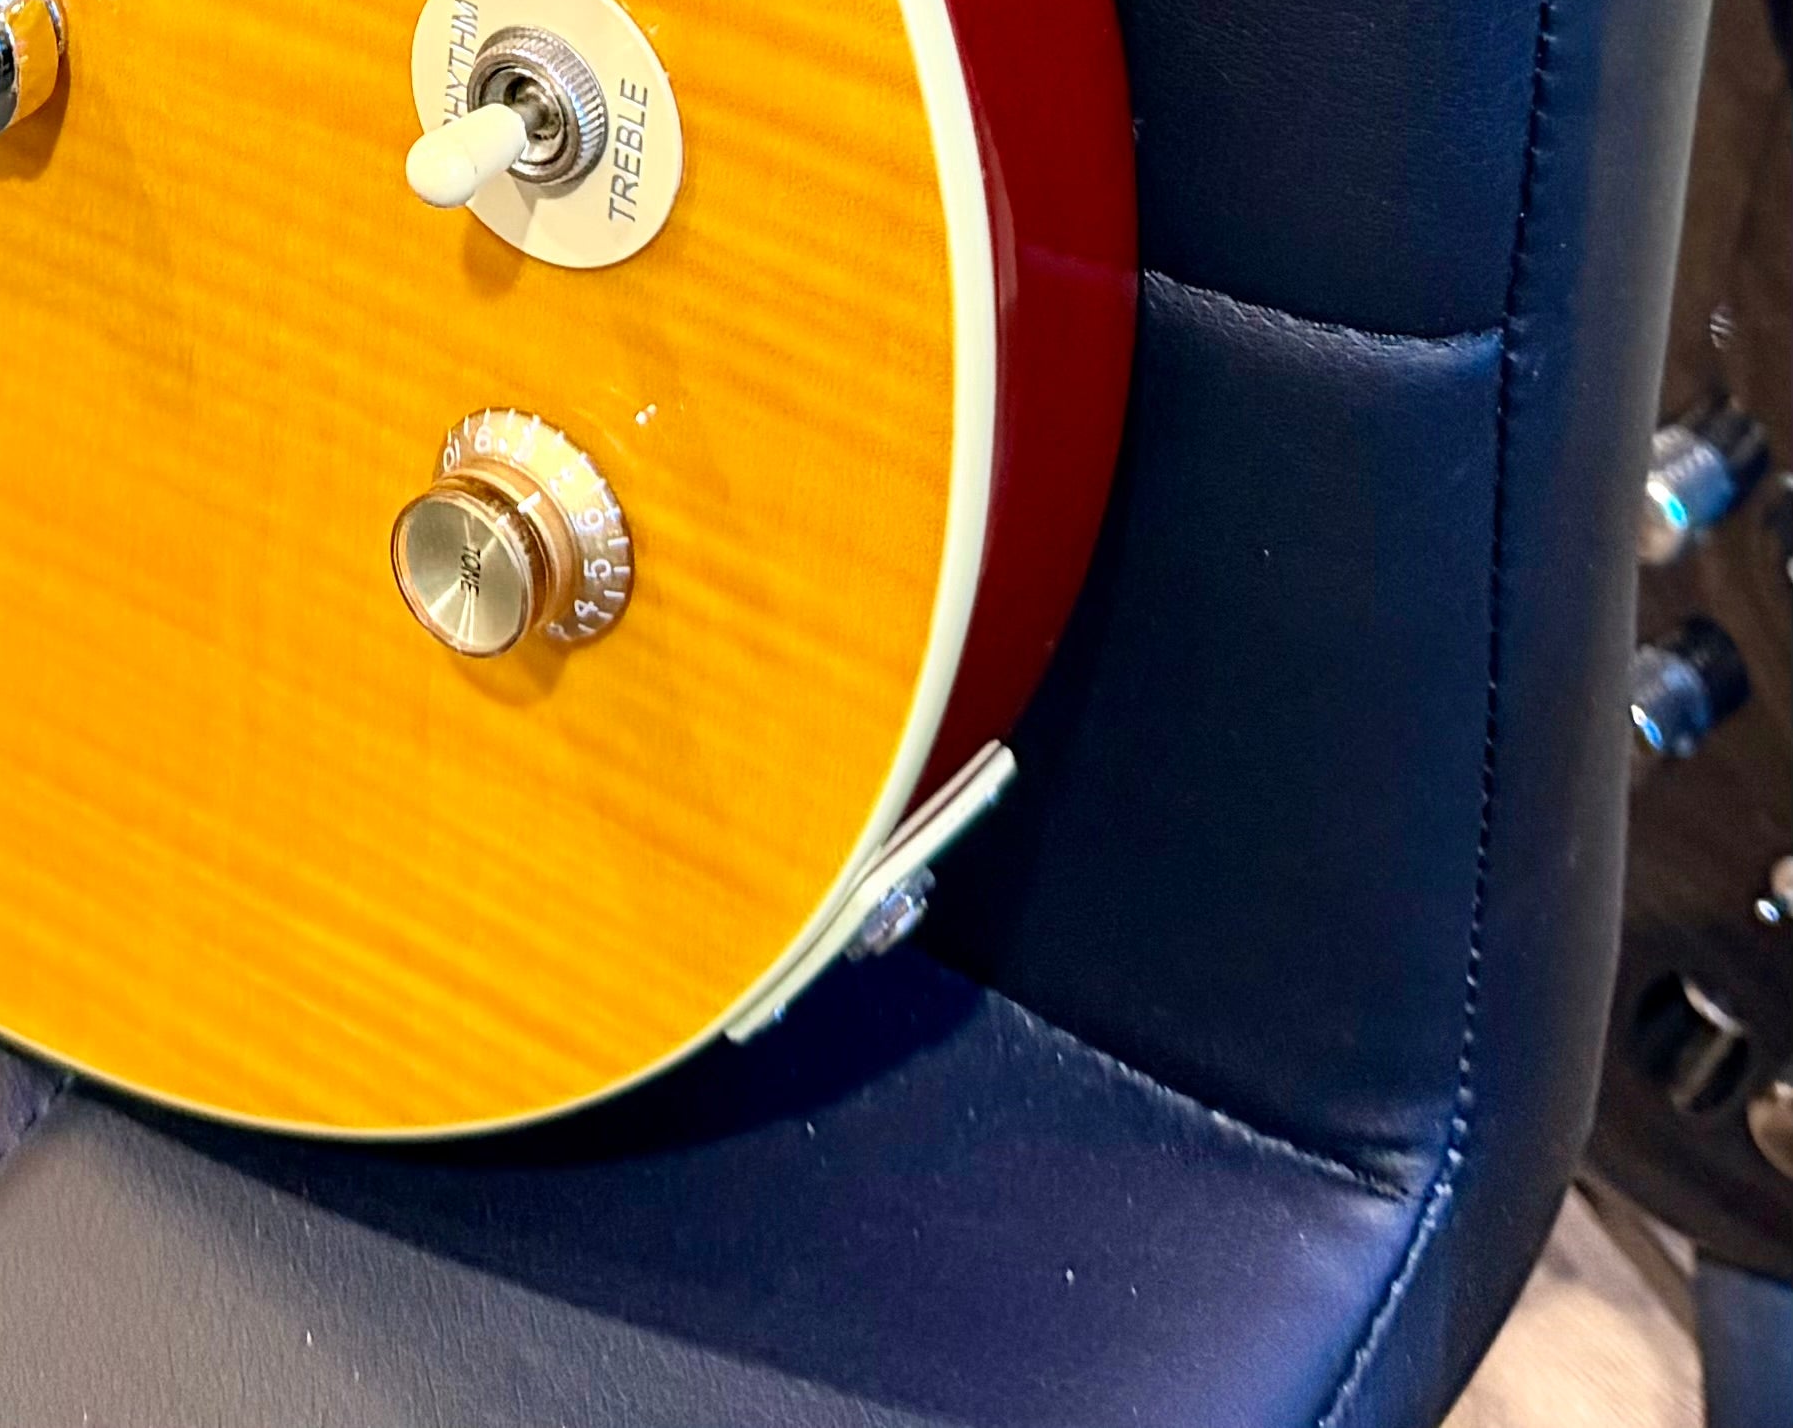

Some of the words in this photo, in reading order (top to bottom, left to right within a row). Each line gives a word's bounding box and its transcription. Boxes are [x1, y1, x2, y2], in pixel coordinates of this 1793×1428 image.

[608, 77, 649, 223] TREBLE
[459, 545, 482, 597] TONE
[583, 558, 612, 580] 5
[574, 598, 599, 617] 4
